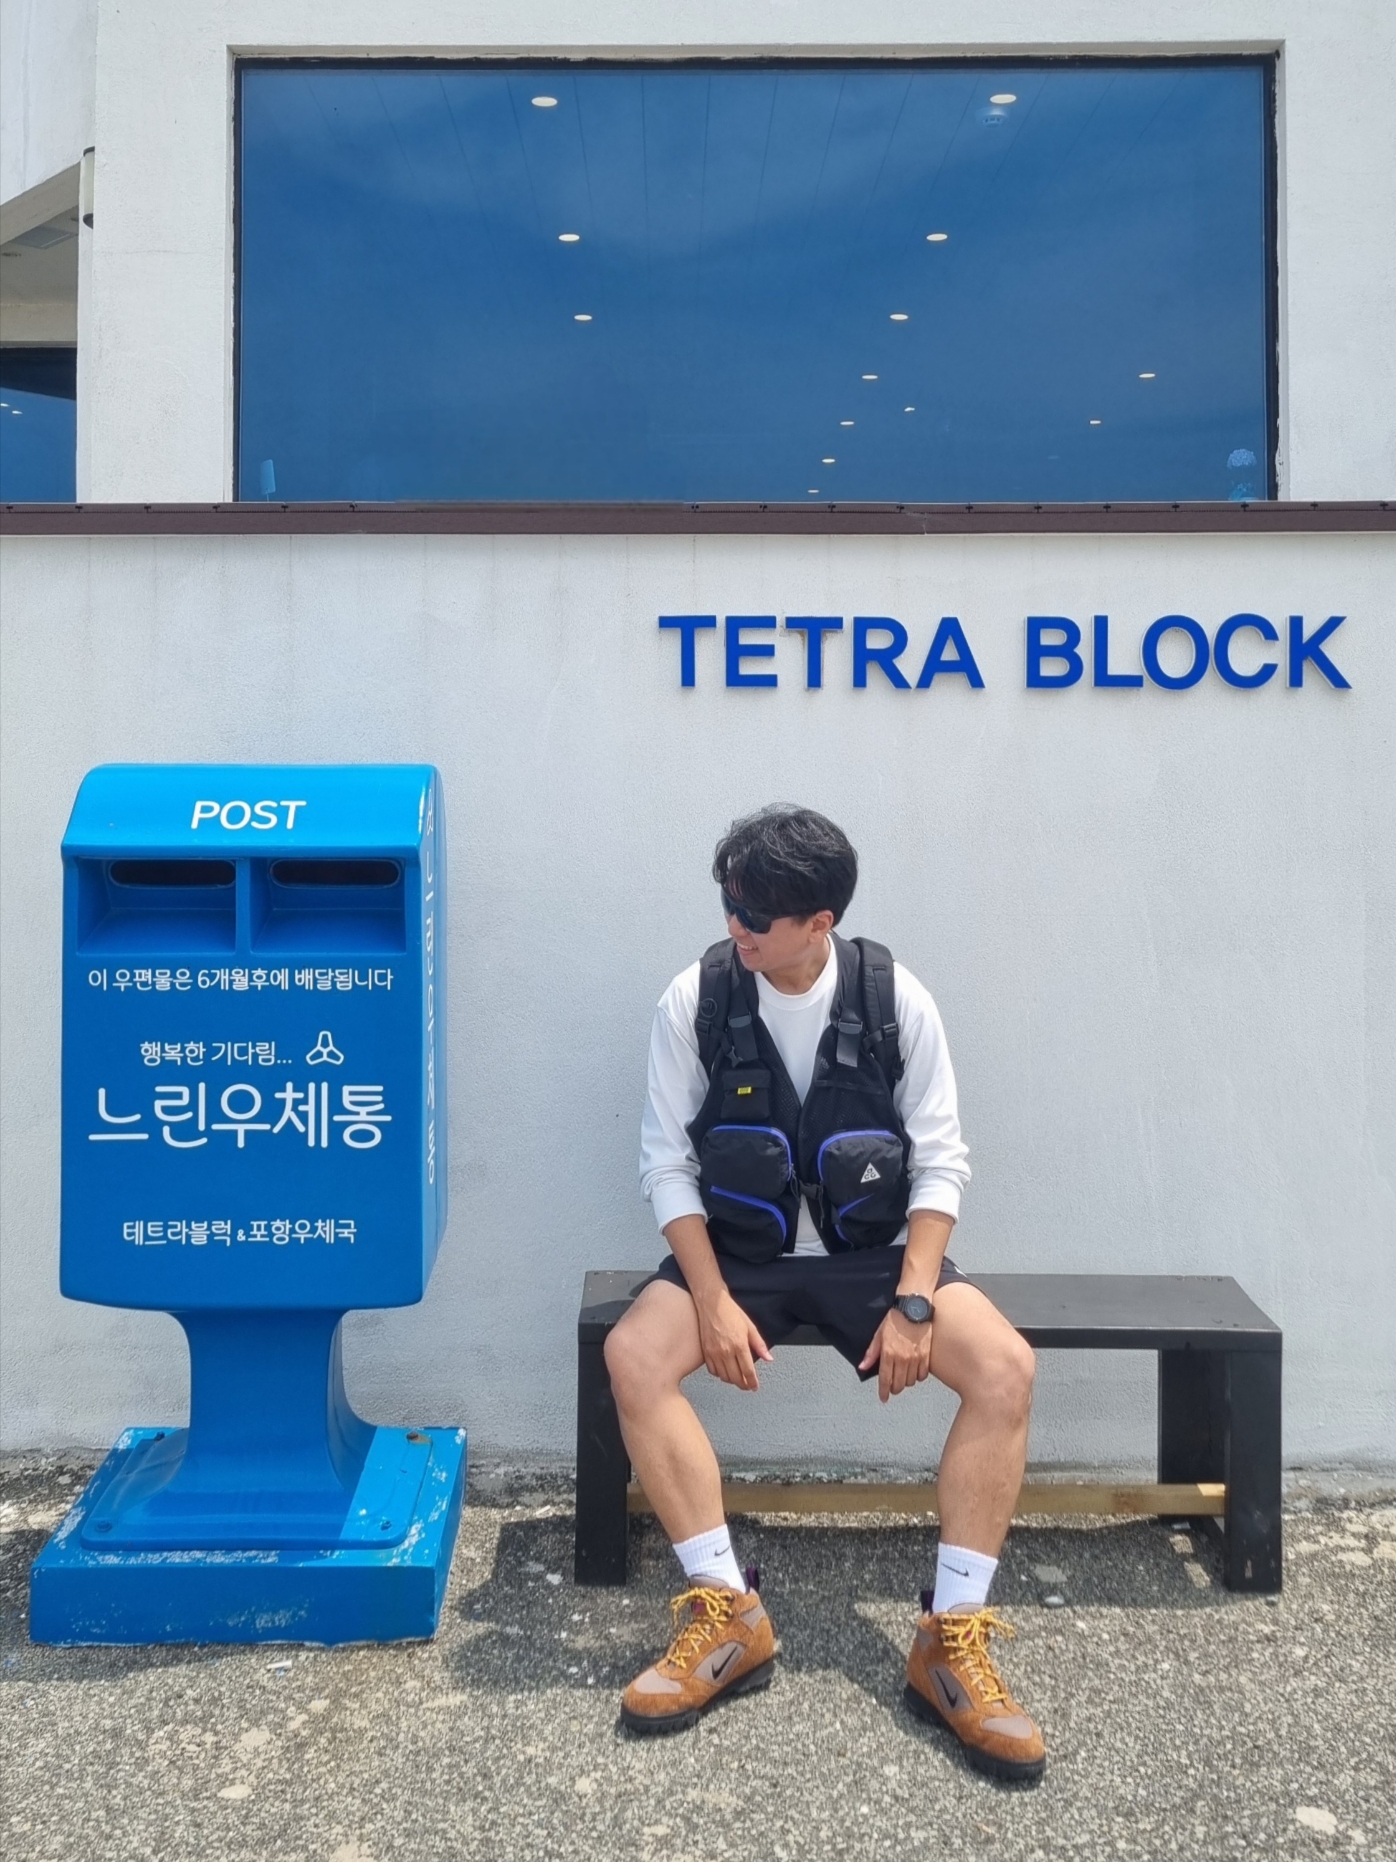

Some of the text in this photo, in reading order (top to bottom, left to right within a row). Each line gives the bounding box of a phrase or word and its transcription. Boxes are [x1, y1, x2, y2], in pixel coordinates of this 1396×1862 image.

[658, 613, 1351, 691] TETRA BLOCK
[190, 799, 308, 831] POST
[87, 967, 395, 993] 이 우편물은 6개월후에 배달됩니다
[139, 1041, 293, 1067] 행복한 기다림...
[87, 1080, 393, 1150] 느린우체통
[122, 1219, 232, 1247] 테트라블럭
